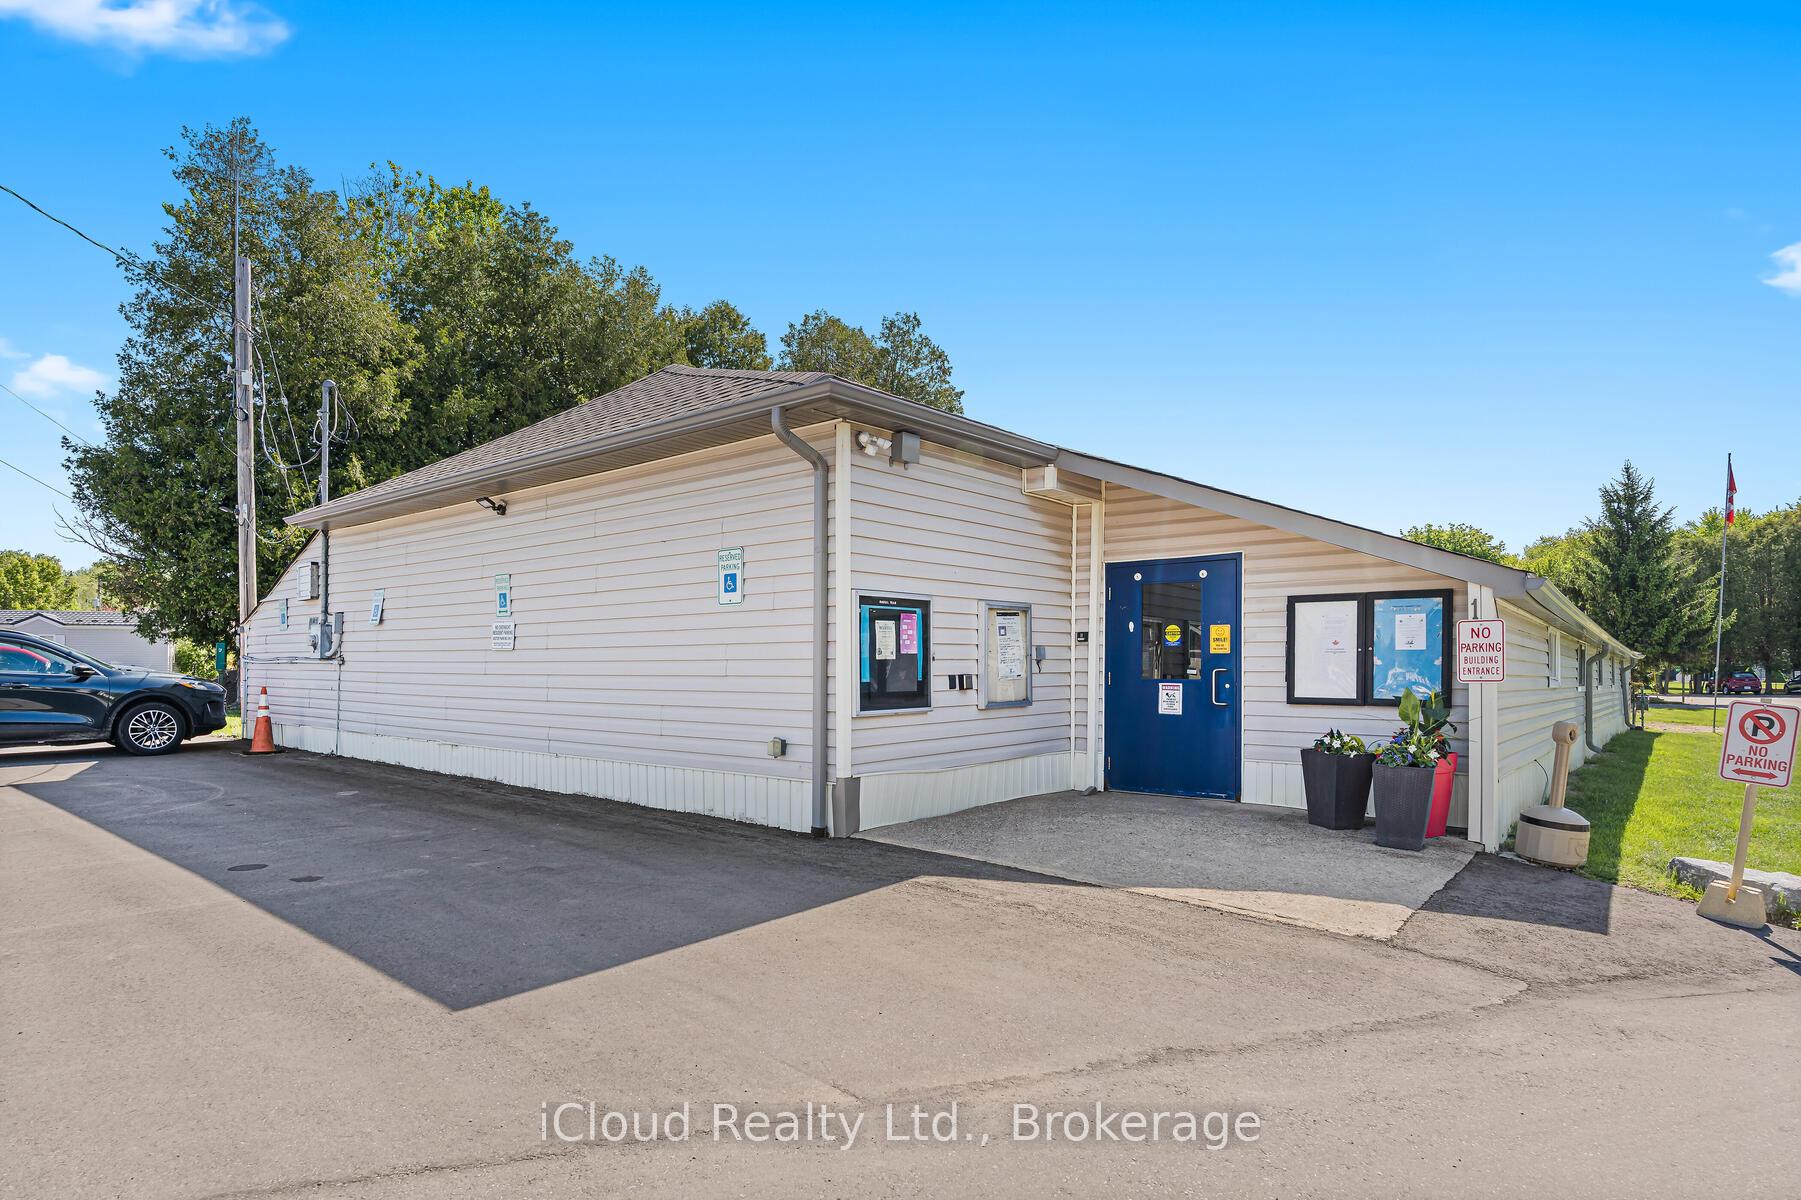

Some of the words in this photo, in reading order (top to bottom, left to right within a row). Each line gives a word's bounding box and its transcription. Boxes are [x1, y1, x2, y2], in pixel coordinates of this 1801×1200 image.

[719, 553, 741, 562] RESERVED
[721, 563, 740, 571] PARKING
[1471, 598, 1478, 620] 1
[1471, 627, 1491, 639] NO
[1461, 643, 1502, 653] PARKING
[1464, 656, 1499, 665] BUILDING
[1463, 667, 1500, 675] ENTRANCE
[1749, 745, 1768, 758] NO
[1726, 754, 1788, 772] PARKING
